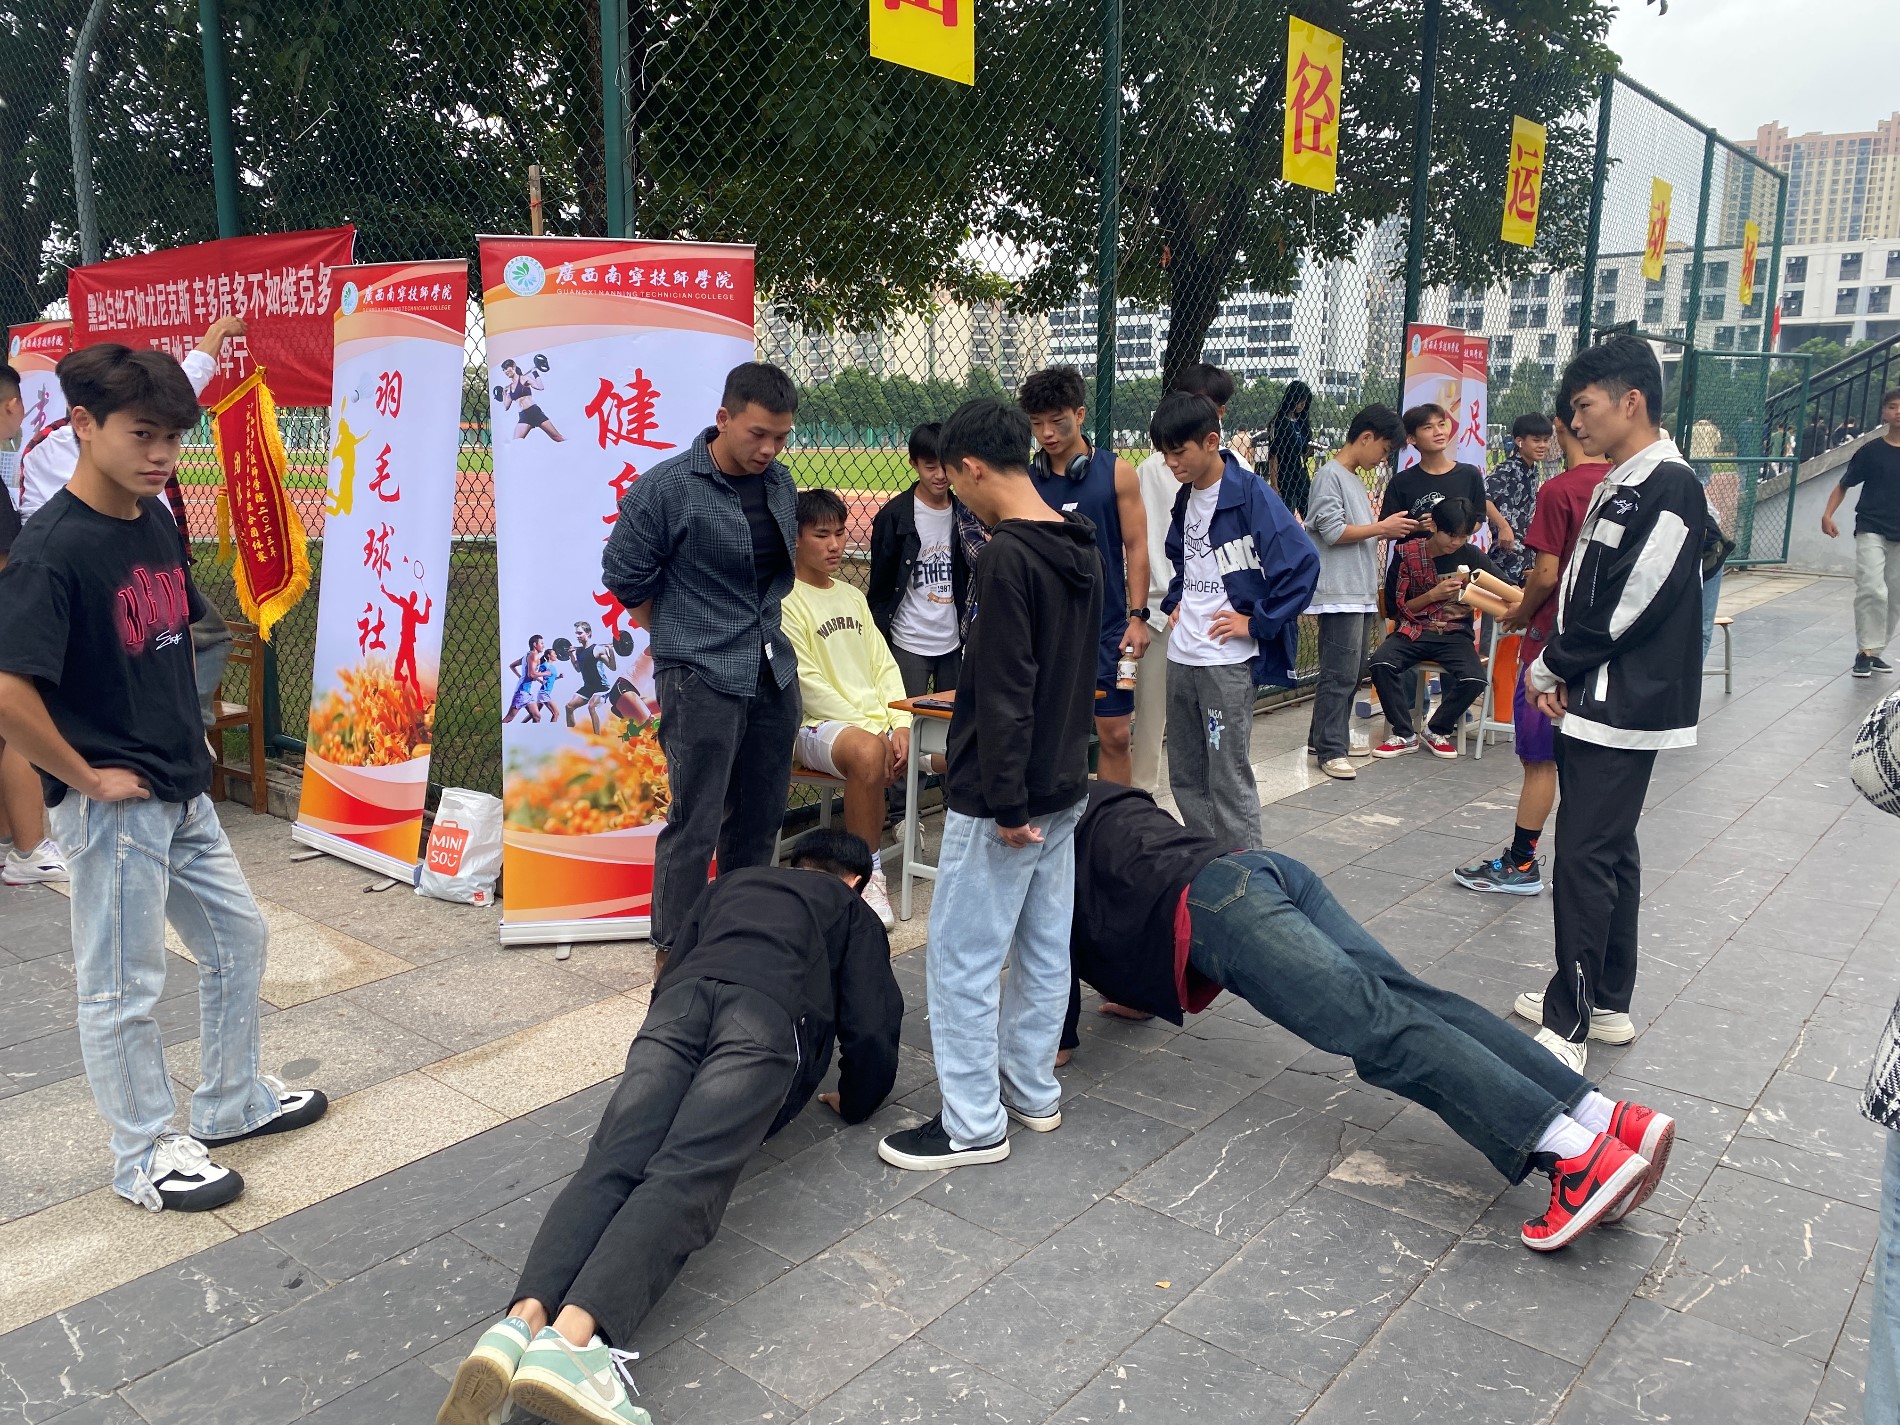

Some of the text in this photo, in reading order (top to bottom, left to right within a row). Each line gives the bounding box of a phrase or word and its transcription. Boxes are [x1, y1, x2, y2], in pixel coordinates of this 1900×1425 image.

[1290, 51, 1336, 156] 径
[1508, 143, 1540, 223] 运
[1648, 200, 1667, 261] 动
[1742, 235, 1756, 289] 场
[87, 262, 332, 332] 黑丝白丝不如尤尼克斯 车多房多不如维克多
[640, 291, 693, 299] TECHNICIAN
[695, 292, 735, 300] COLLEGE
[356, 369, 404, 657] 羽毛球社
[431, 833, 463, 851] MINI
[509, 1318, 526, 1330] AIR
